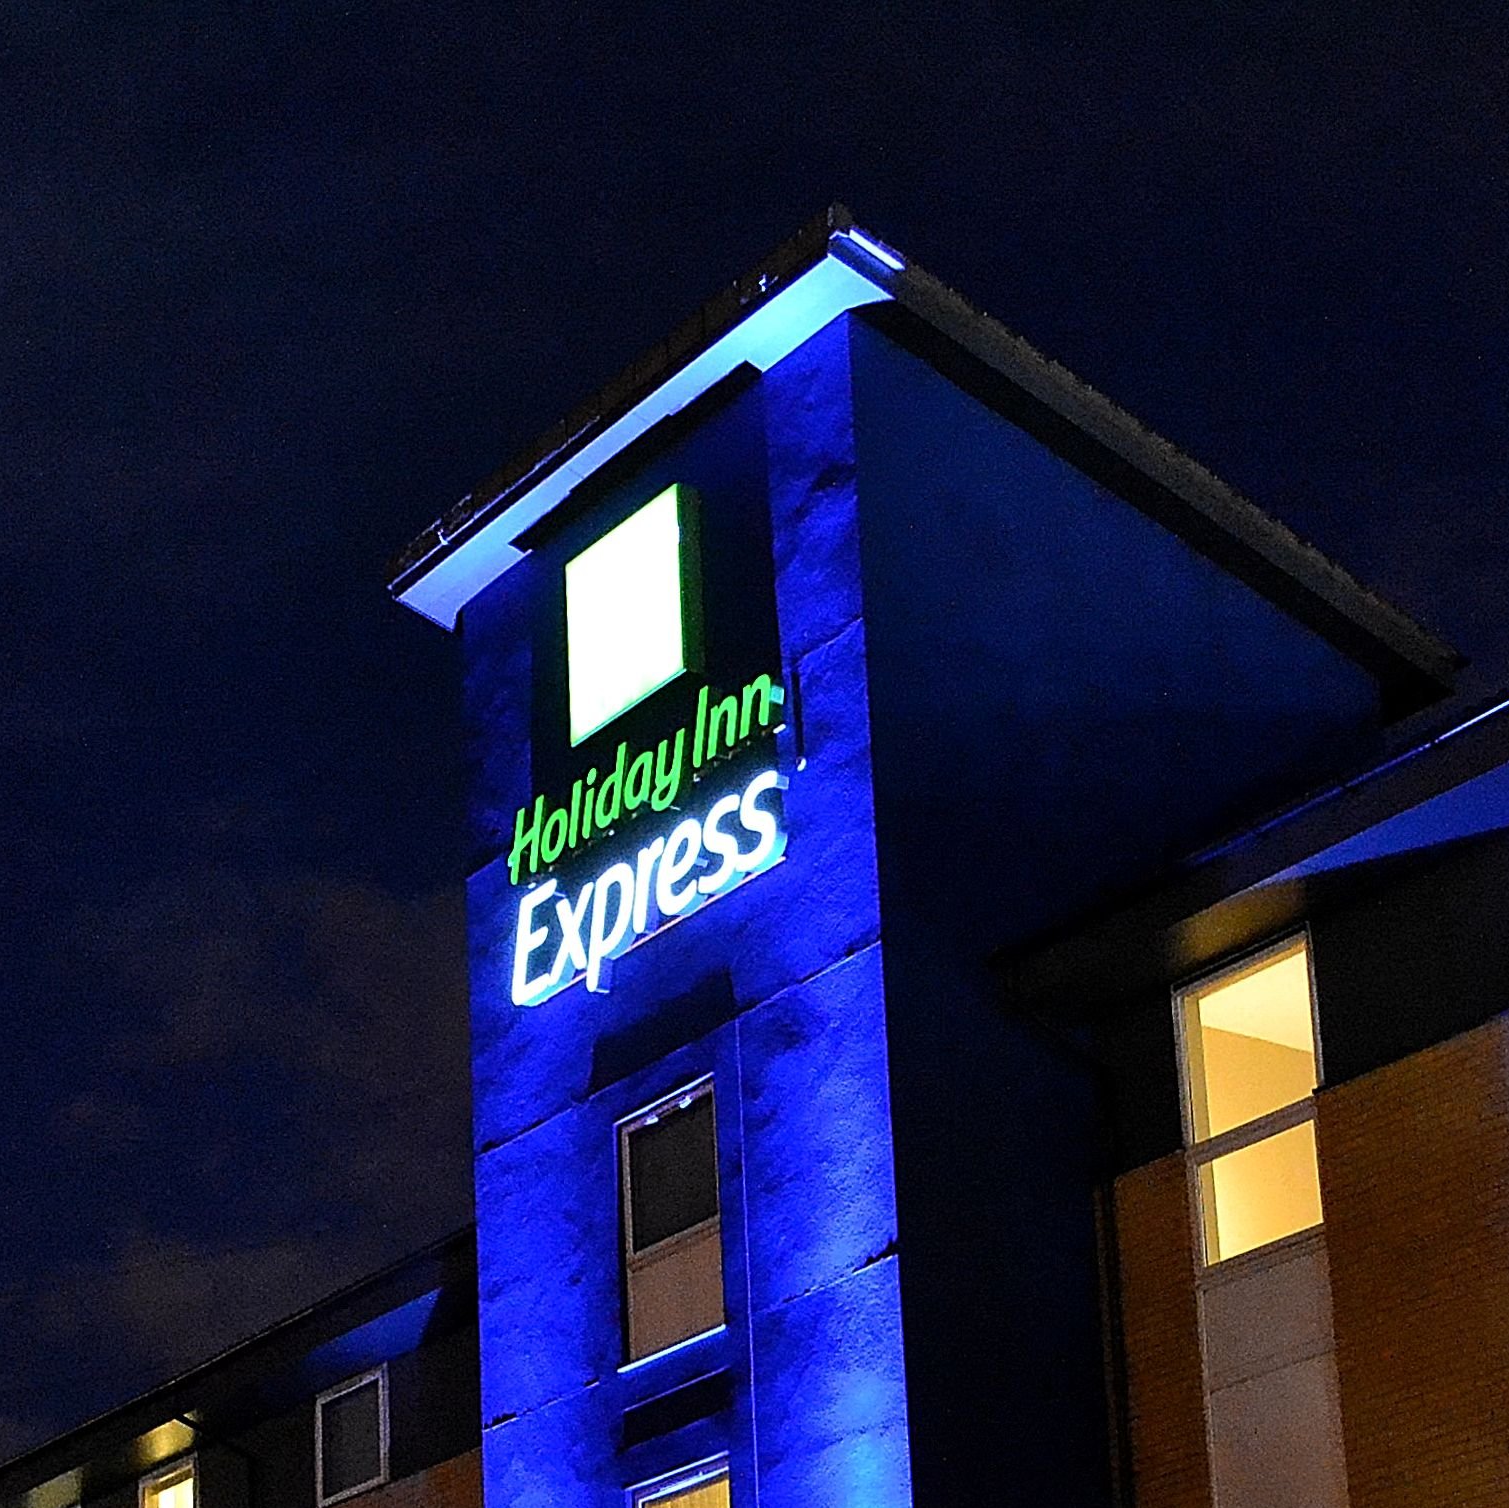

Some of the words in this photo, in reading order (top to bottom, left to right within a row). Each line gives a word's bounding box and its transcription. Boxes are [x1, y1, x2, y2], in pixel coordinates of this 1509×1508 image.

[510, 728, 686, 885] Holiday
[692, 673, 772, 768] Inn
[511, 769, 785, 1006] Express
